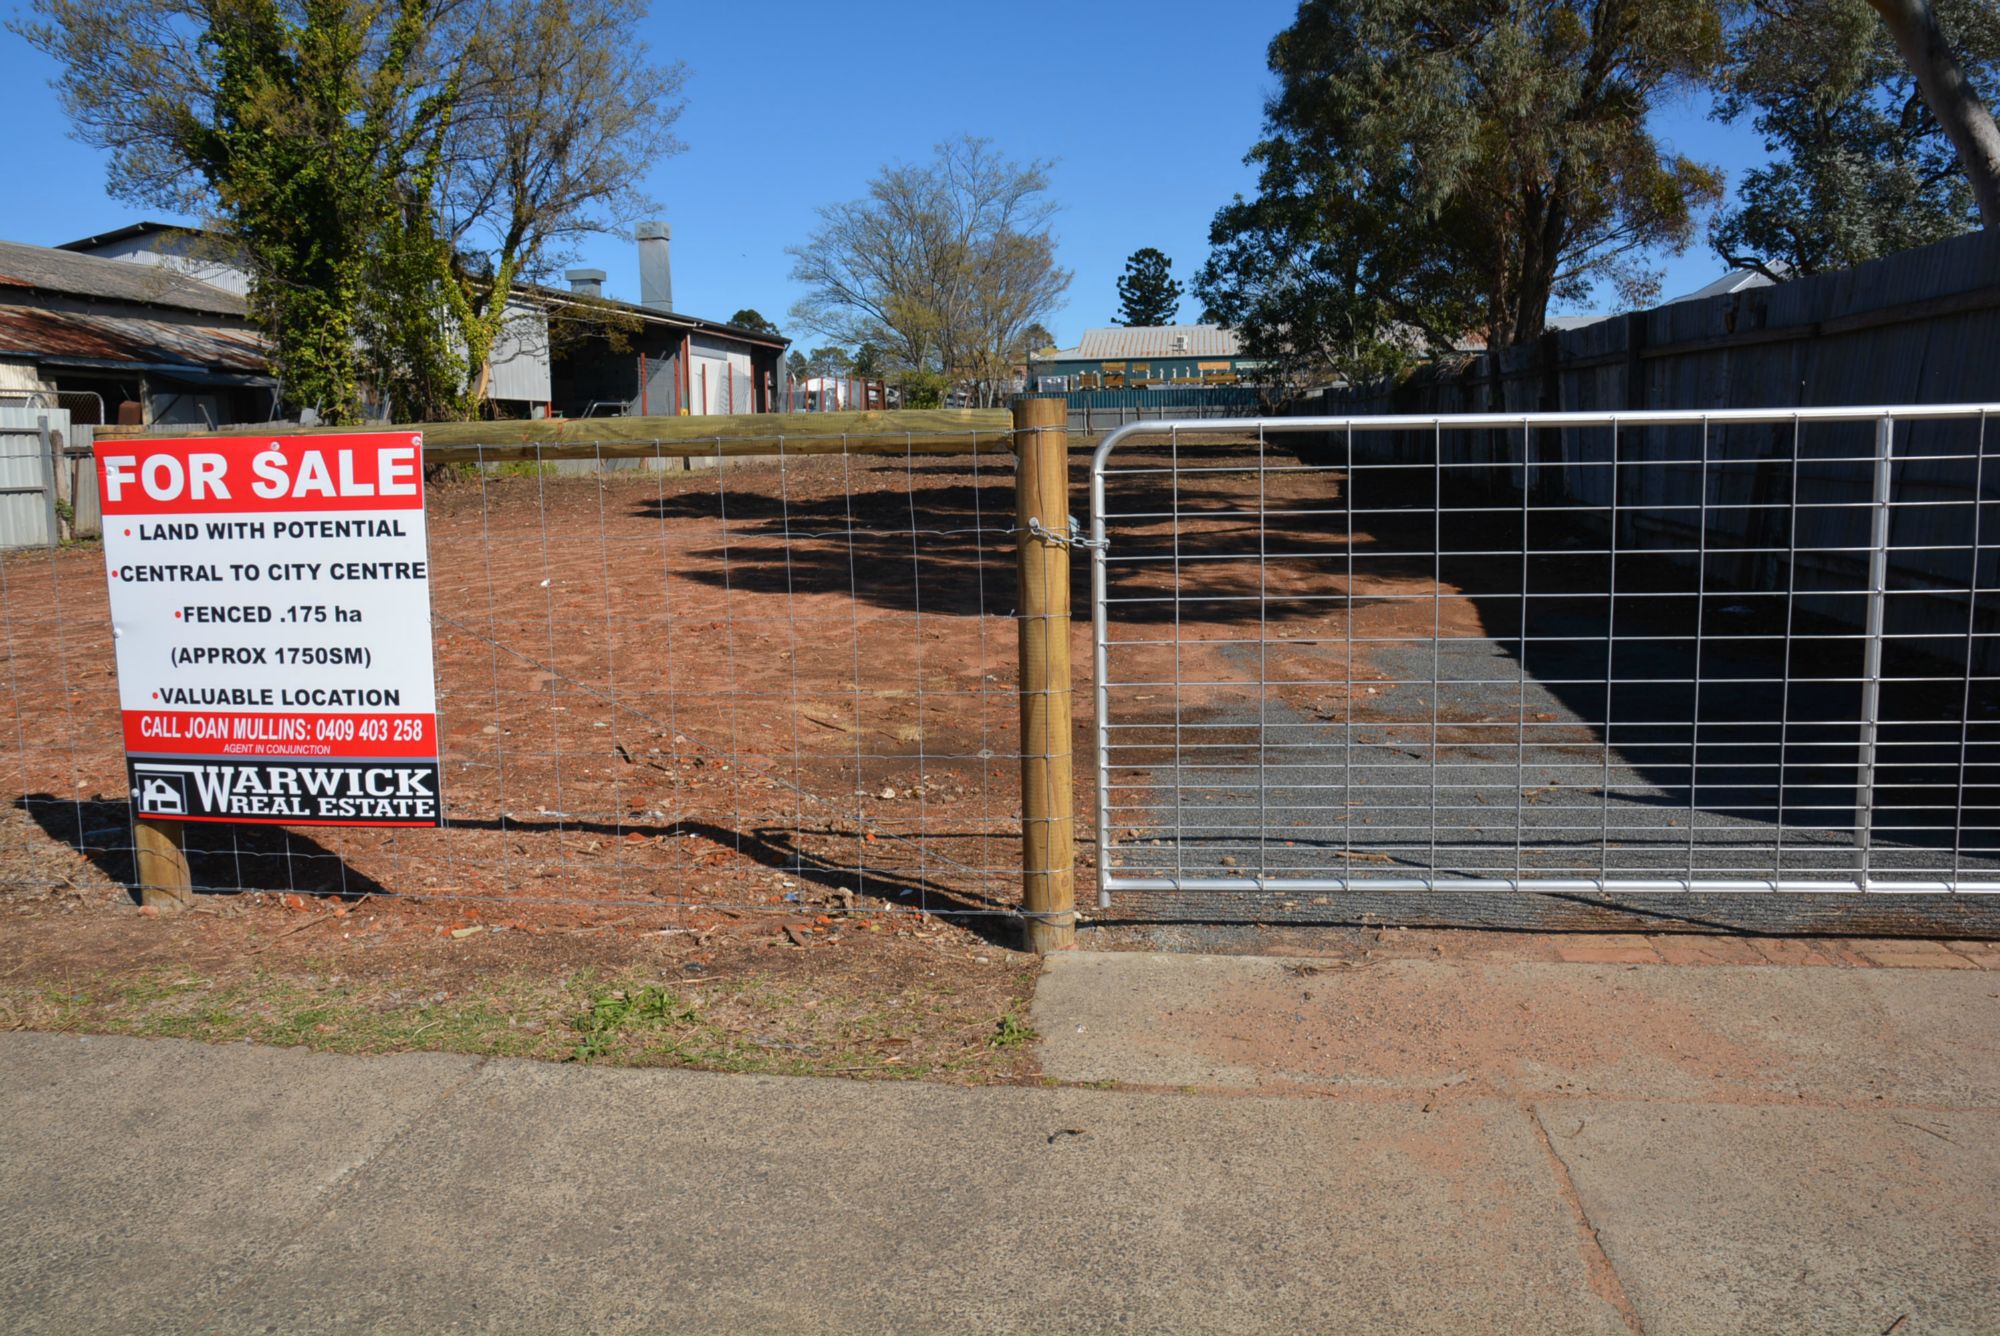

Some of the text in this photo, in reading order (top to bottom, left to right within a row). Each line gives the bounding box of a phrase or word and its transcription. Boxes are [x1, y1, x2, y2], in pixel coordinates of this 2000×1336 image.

[103, 448, 417, 502] FOR SALE
[139, 520, 406, 541] LAND WITH POTENTIAL
[120, 562, 426, 582] CENTRAL TO CITY CENTRE
[183, 605, 362, 623] FENCED .175 ha
[171, 647, 372, 669] (APPROX 1750SM)
[159, 688, 400, 706] VALUABLE LOCATION
[140, 716, 423, 742] CALL JOAN MULLINS: 0409 403 258
[223, 743, 331, 755] AGENT IN CONJUNCTION
[193, 765, 433, 813] WARWICK
[231, 796, 435, 817] REAL ESTATE
